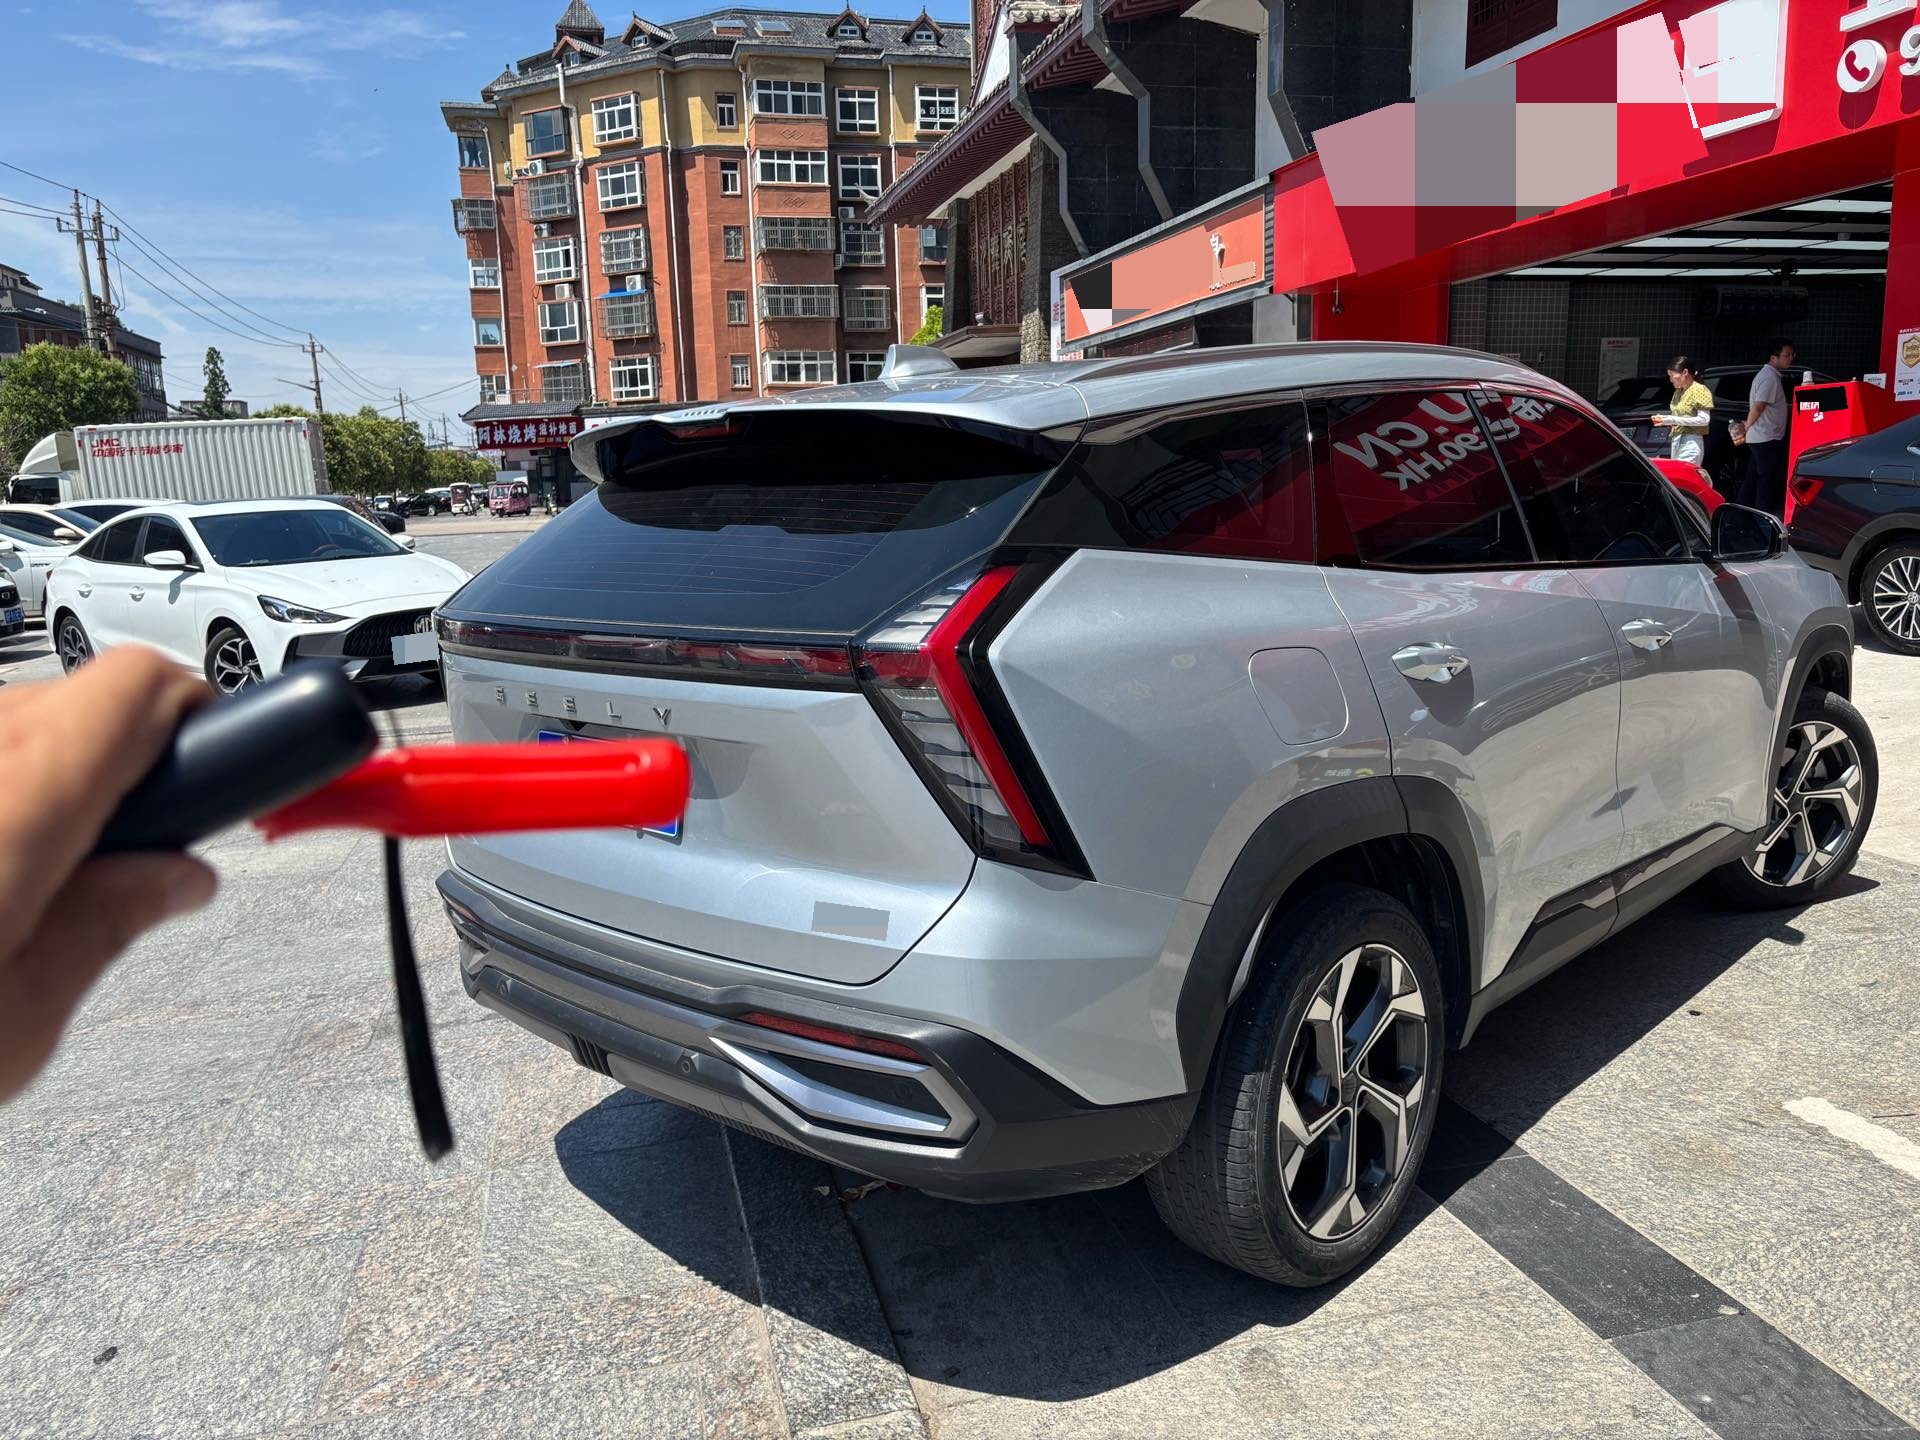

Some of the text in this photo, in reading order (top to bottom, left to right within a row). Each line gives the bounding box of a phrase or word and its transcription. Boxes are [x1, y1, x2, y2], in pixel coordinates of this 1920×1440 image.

[478, 424, 537, 445] 阿林烧烤
[91, 438, 120, 448] JMC
